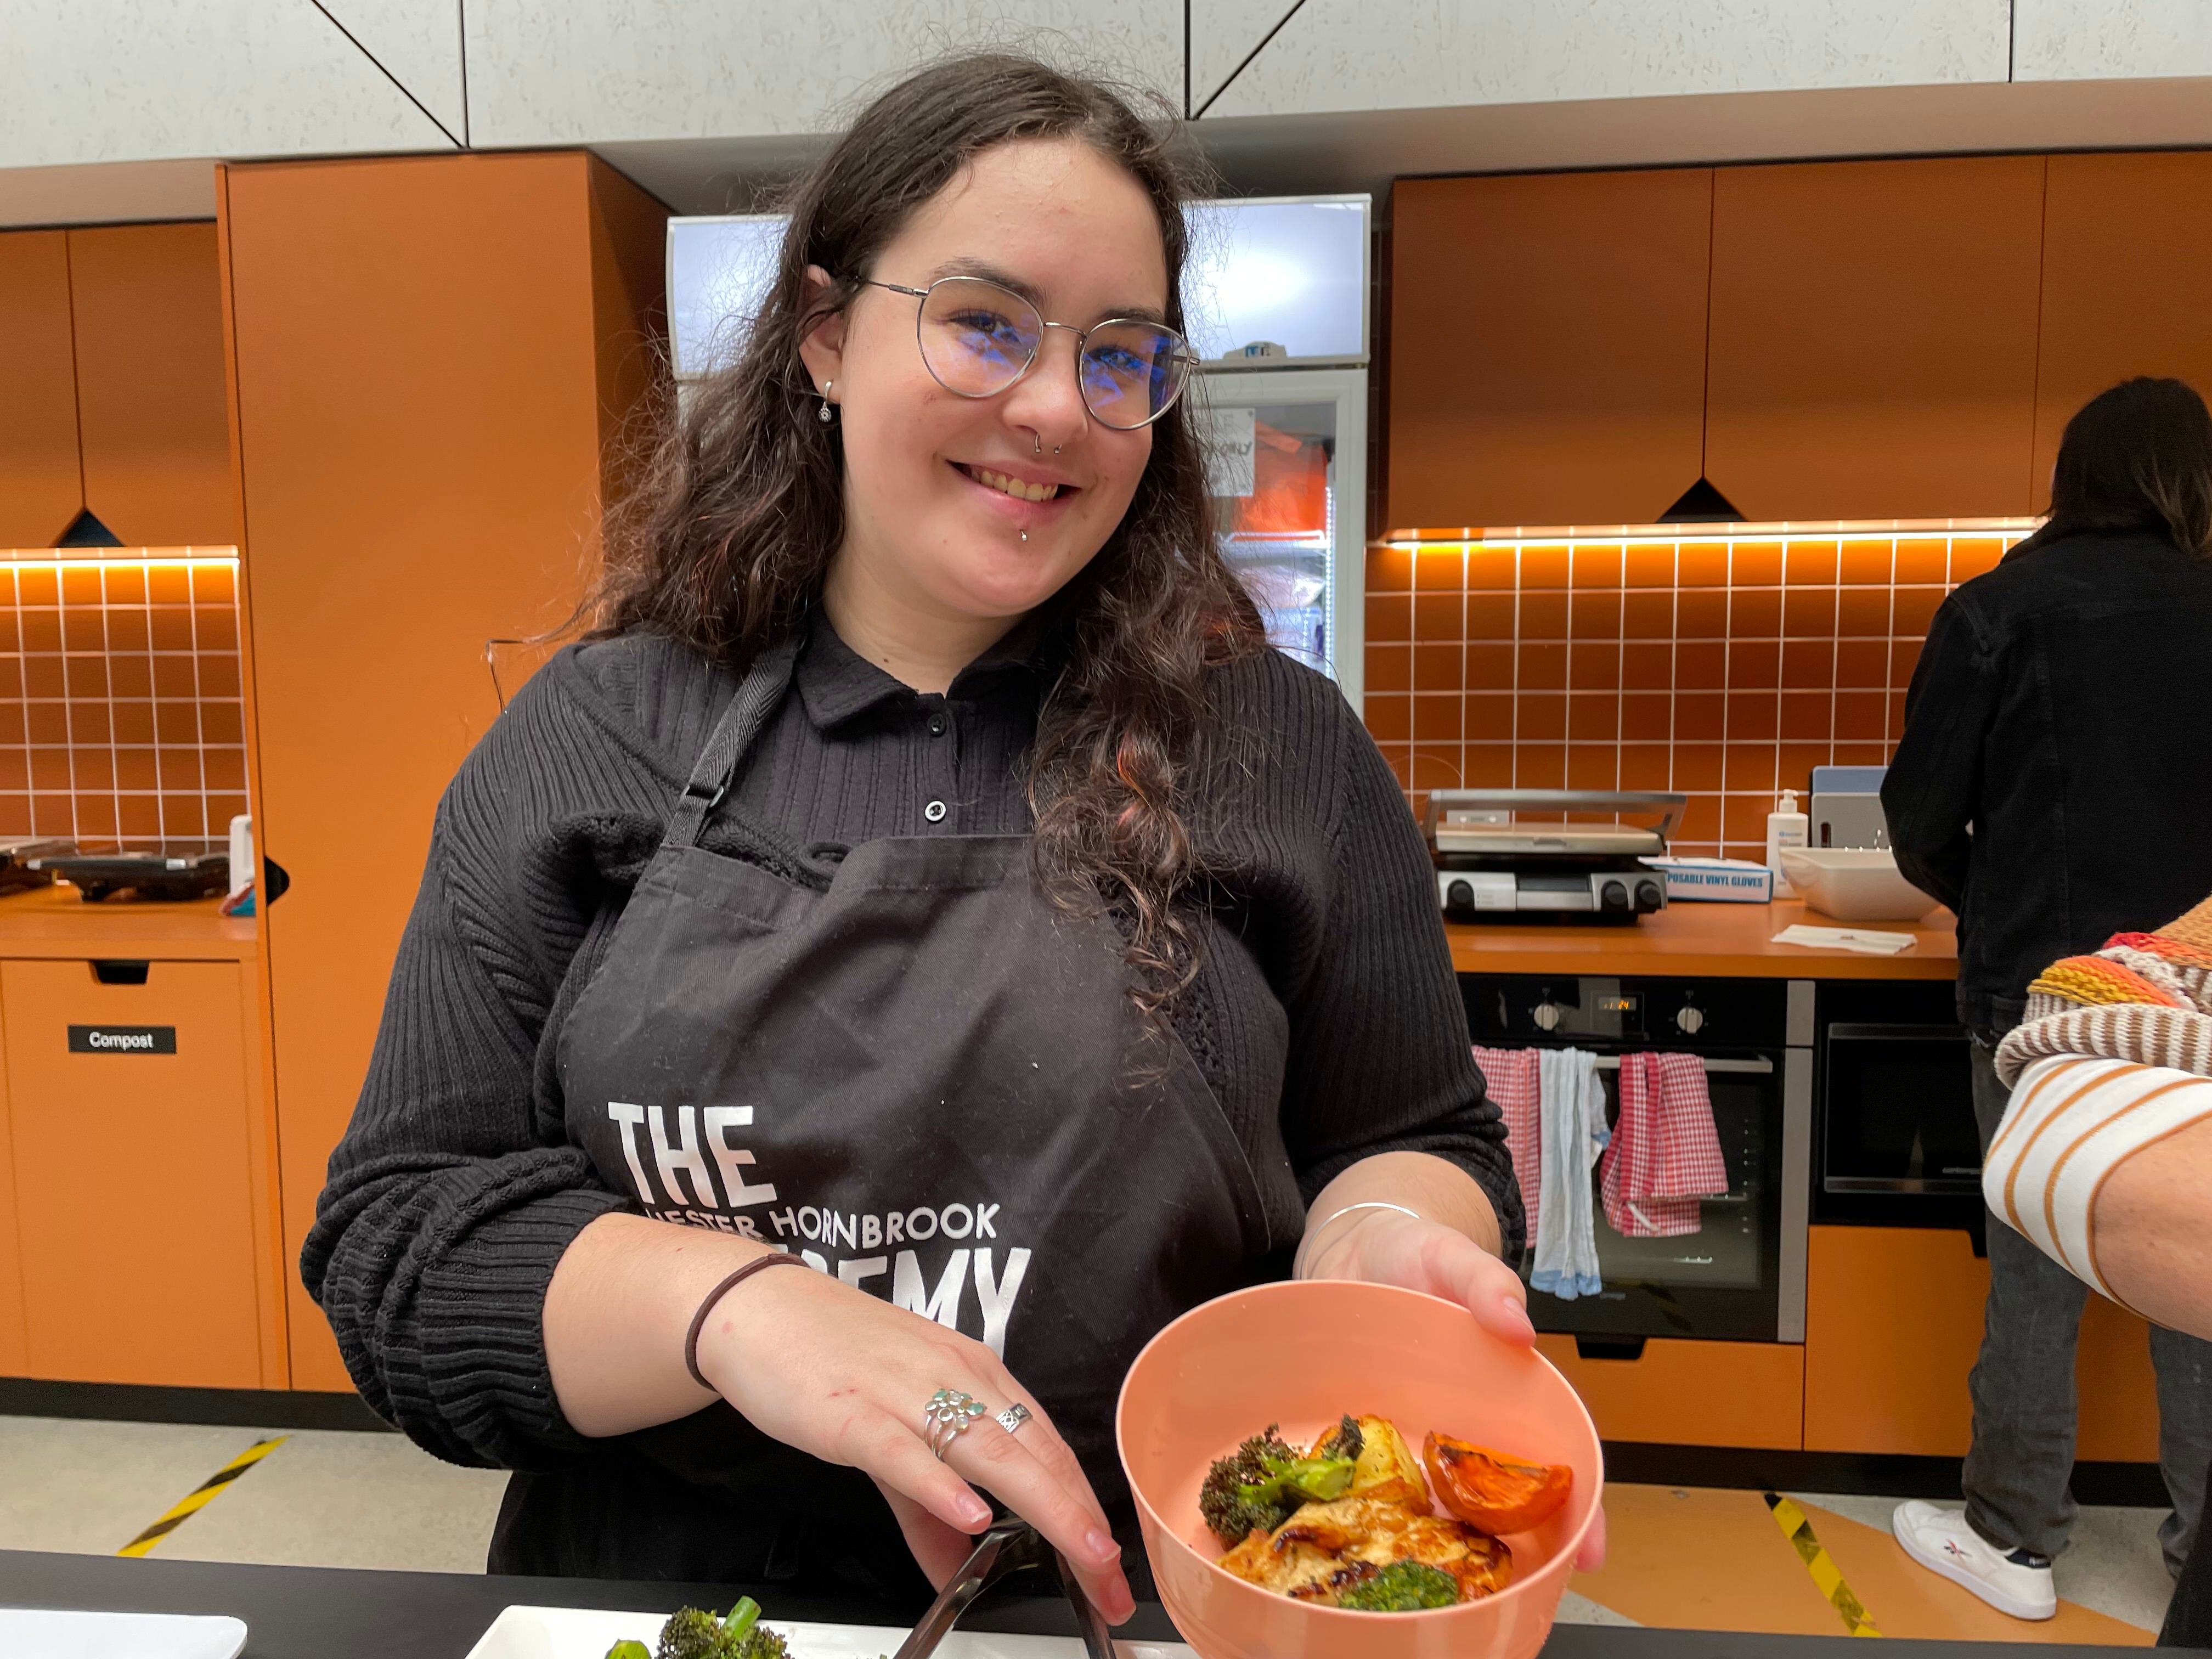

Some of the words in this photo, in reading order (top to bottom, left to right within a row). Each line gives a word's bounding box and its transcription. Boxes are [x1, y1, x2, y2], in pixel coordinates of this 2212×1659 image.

[1667, 873, 1703, 885] POSABLE
[1706, 875, 1729, 886] VINYL
[1731, 877, 1763, 887] GLOVES
[89, 1031, 154, 1052] Compost
[608, 1102, 777, 1209] THE
[769, 1203, 1000, 1250] HORNBROOK
